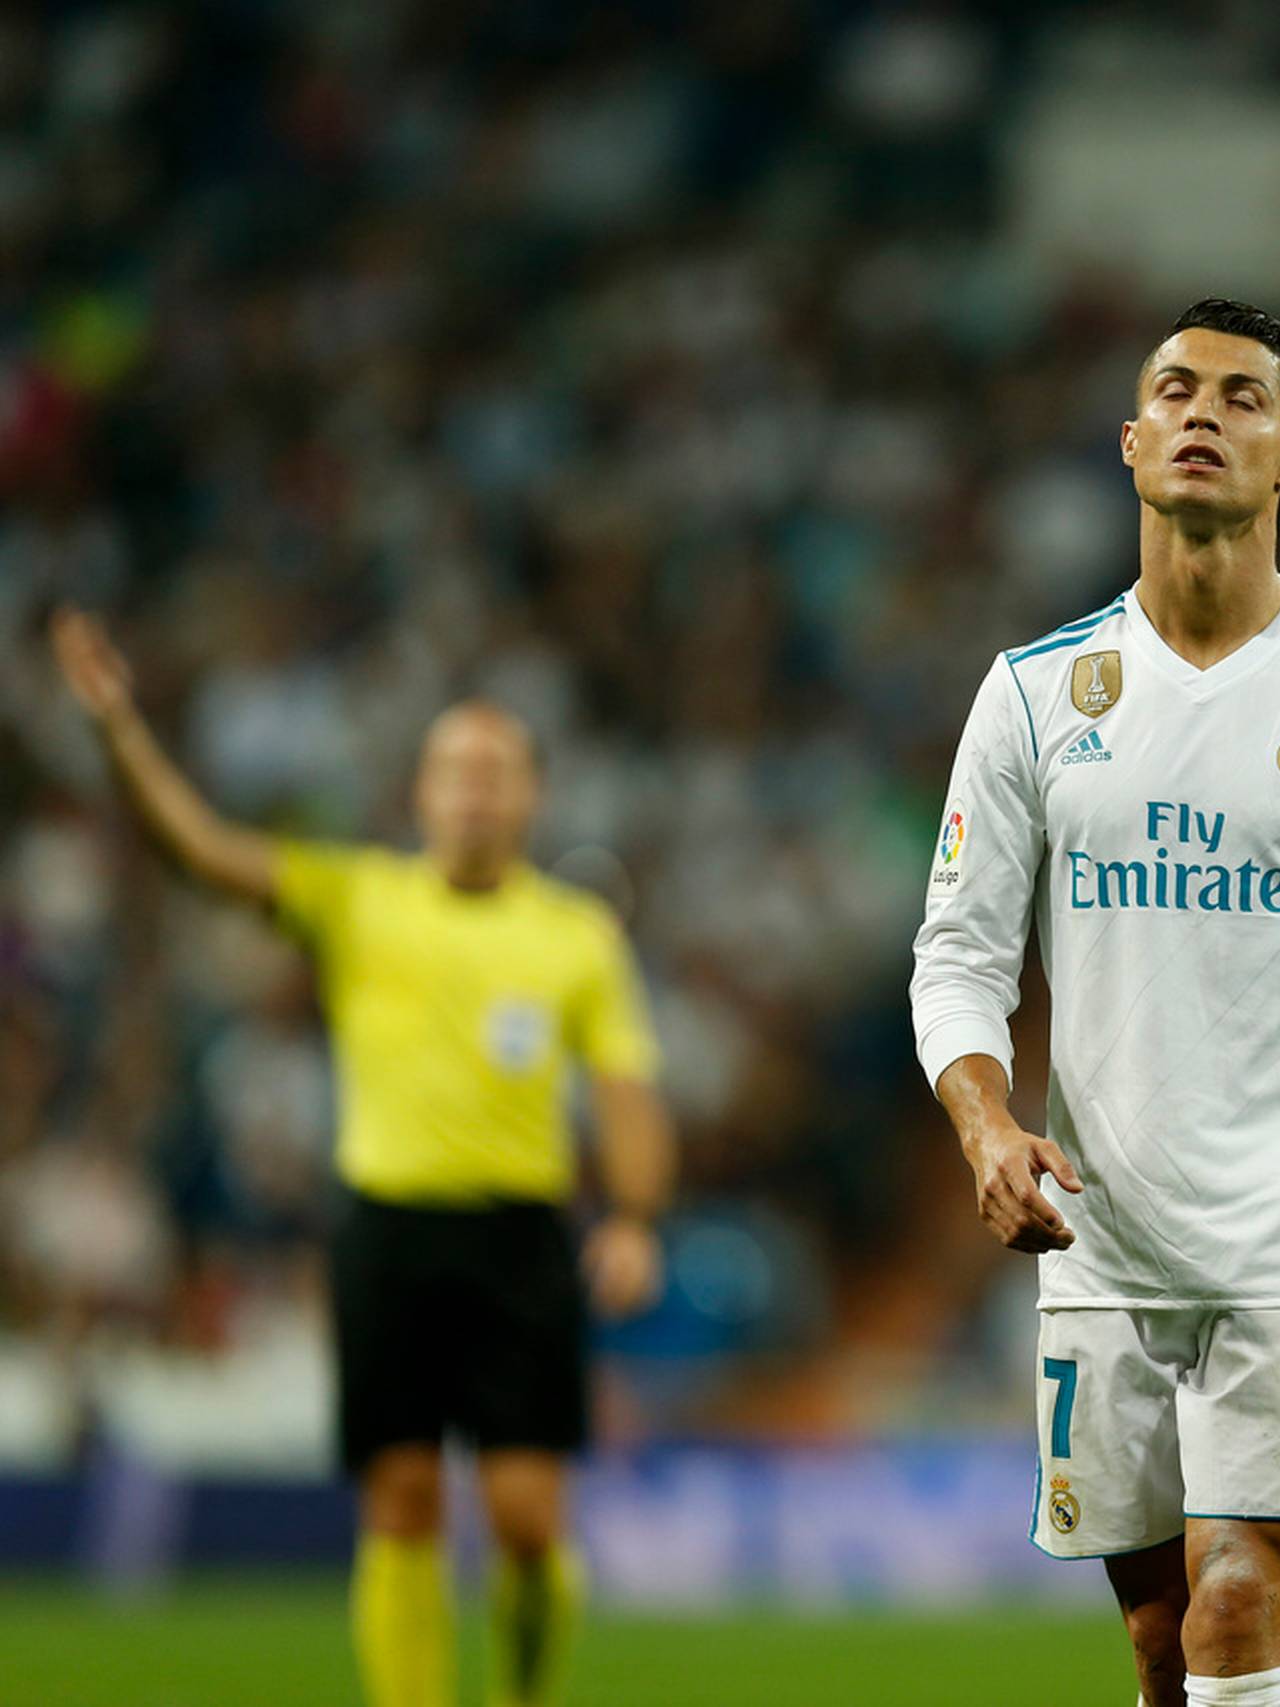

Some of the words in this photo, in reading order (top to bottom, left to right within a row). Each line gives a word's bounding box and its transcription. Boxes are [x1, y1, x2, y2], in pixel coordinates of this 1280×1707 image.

[1061, 751, 1112, 765] adidas
[1146, 801, 1226, 853] Fly
[1044, 1357, 1077, 1459] 7
